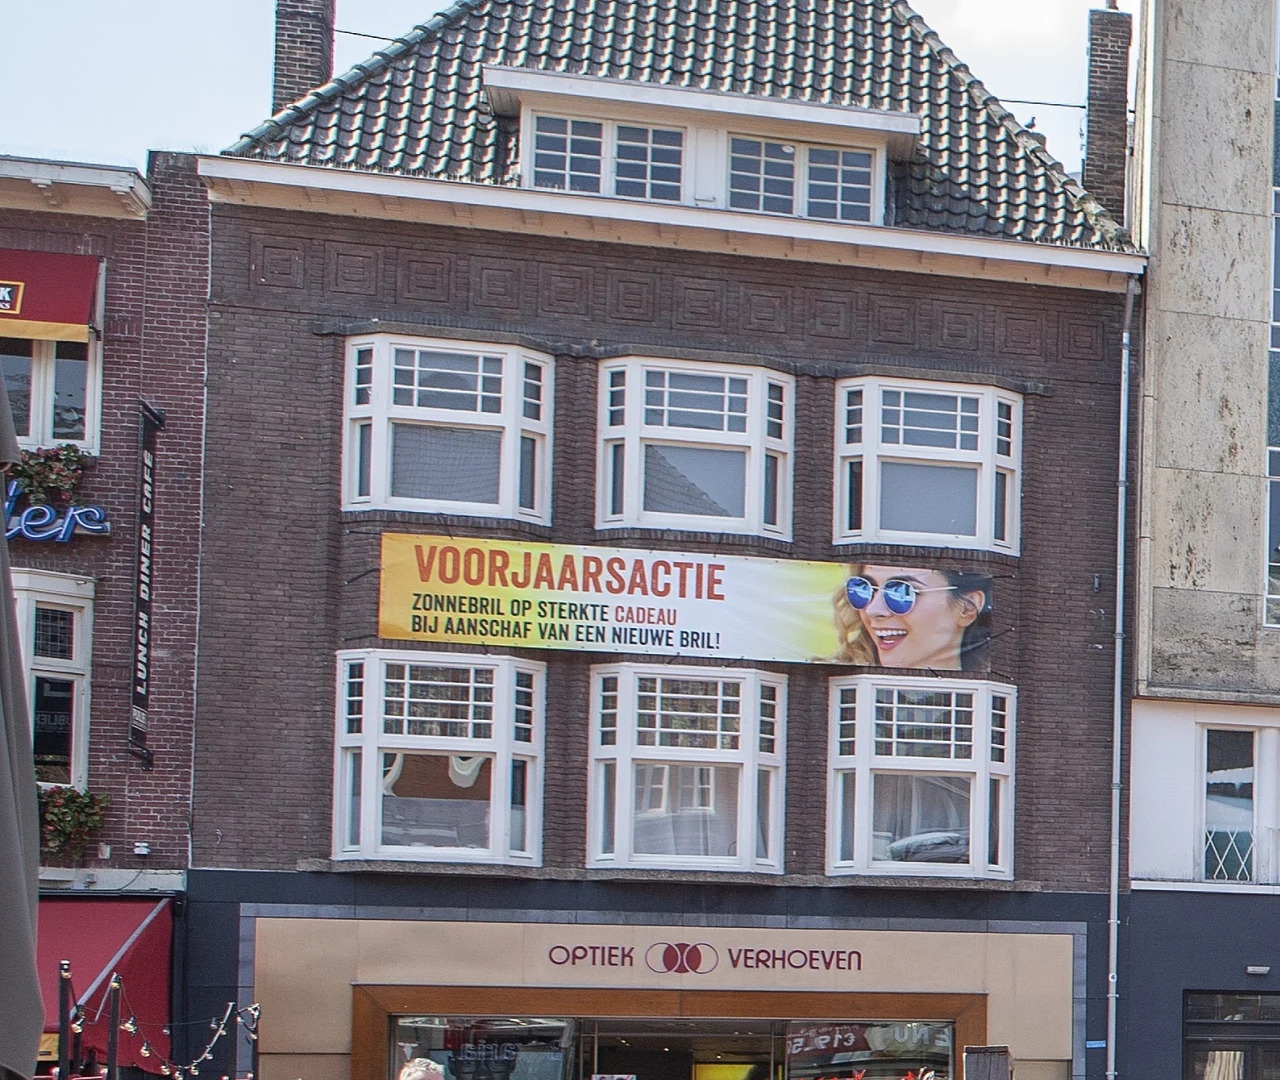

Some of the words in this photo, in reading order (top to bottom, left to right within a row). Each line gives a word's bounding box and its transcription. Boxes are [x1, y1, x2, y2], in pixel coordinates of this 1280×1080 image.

[139, 524, 151, 601] DINER
[414, 544, 726, 600] VOORJAARSACTIE
[412, 593, 505, 616] ZONNEBRIL
[511, 598, 531, 617] OP
[537, 601, 609, 622] STERKTE
[615, 606, 677, 625] CADEAU
[136, 612, 149, 694] LUNCH
[412, 615, 438, 634] BIJ
[444, 618, 532, 639] AANSCHAF
[538, 622, 569, 641] VAN
[576, 624, 606, 643] EEN
[612, 626, 674, 648] NIEUWE
[680, 631, 721, 649] BRIL!
[549, 945, 634, 966] OPTIEK
[727, 948, 862, 970] VERHOEVEN
